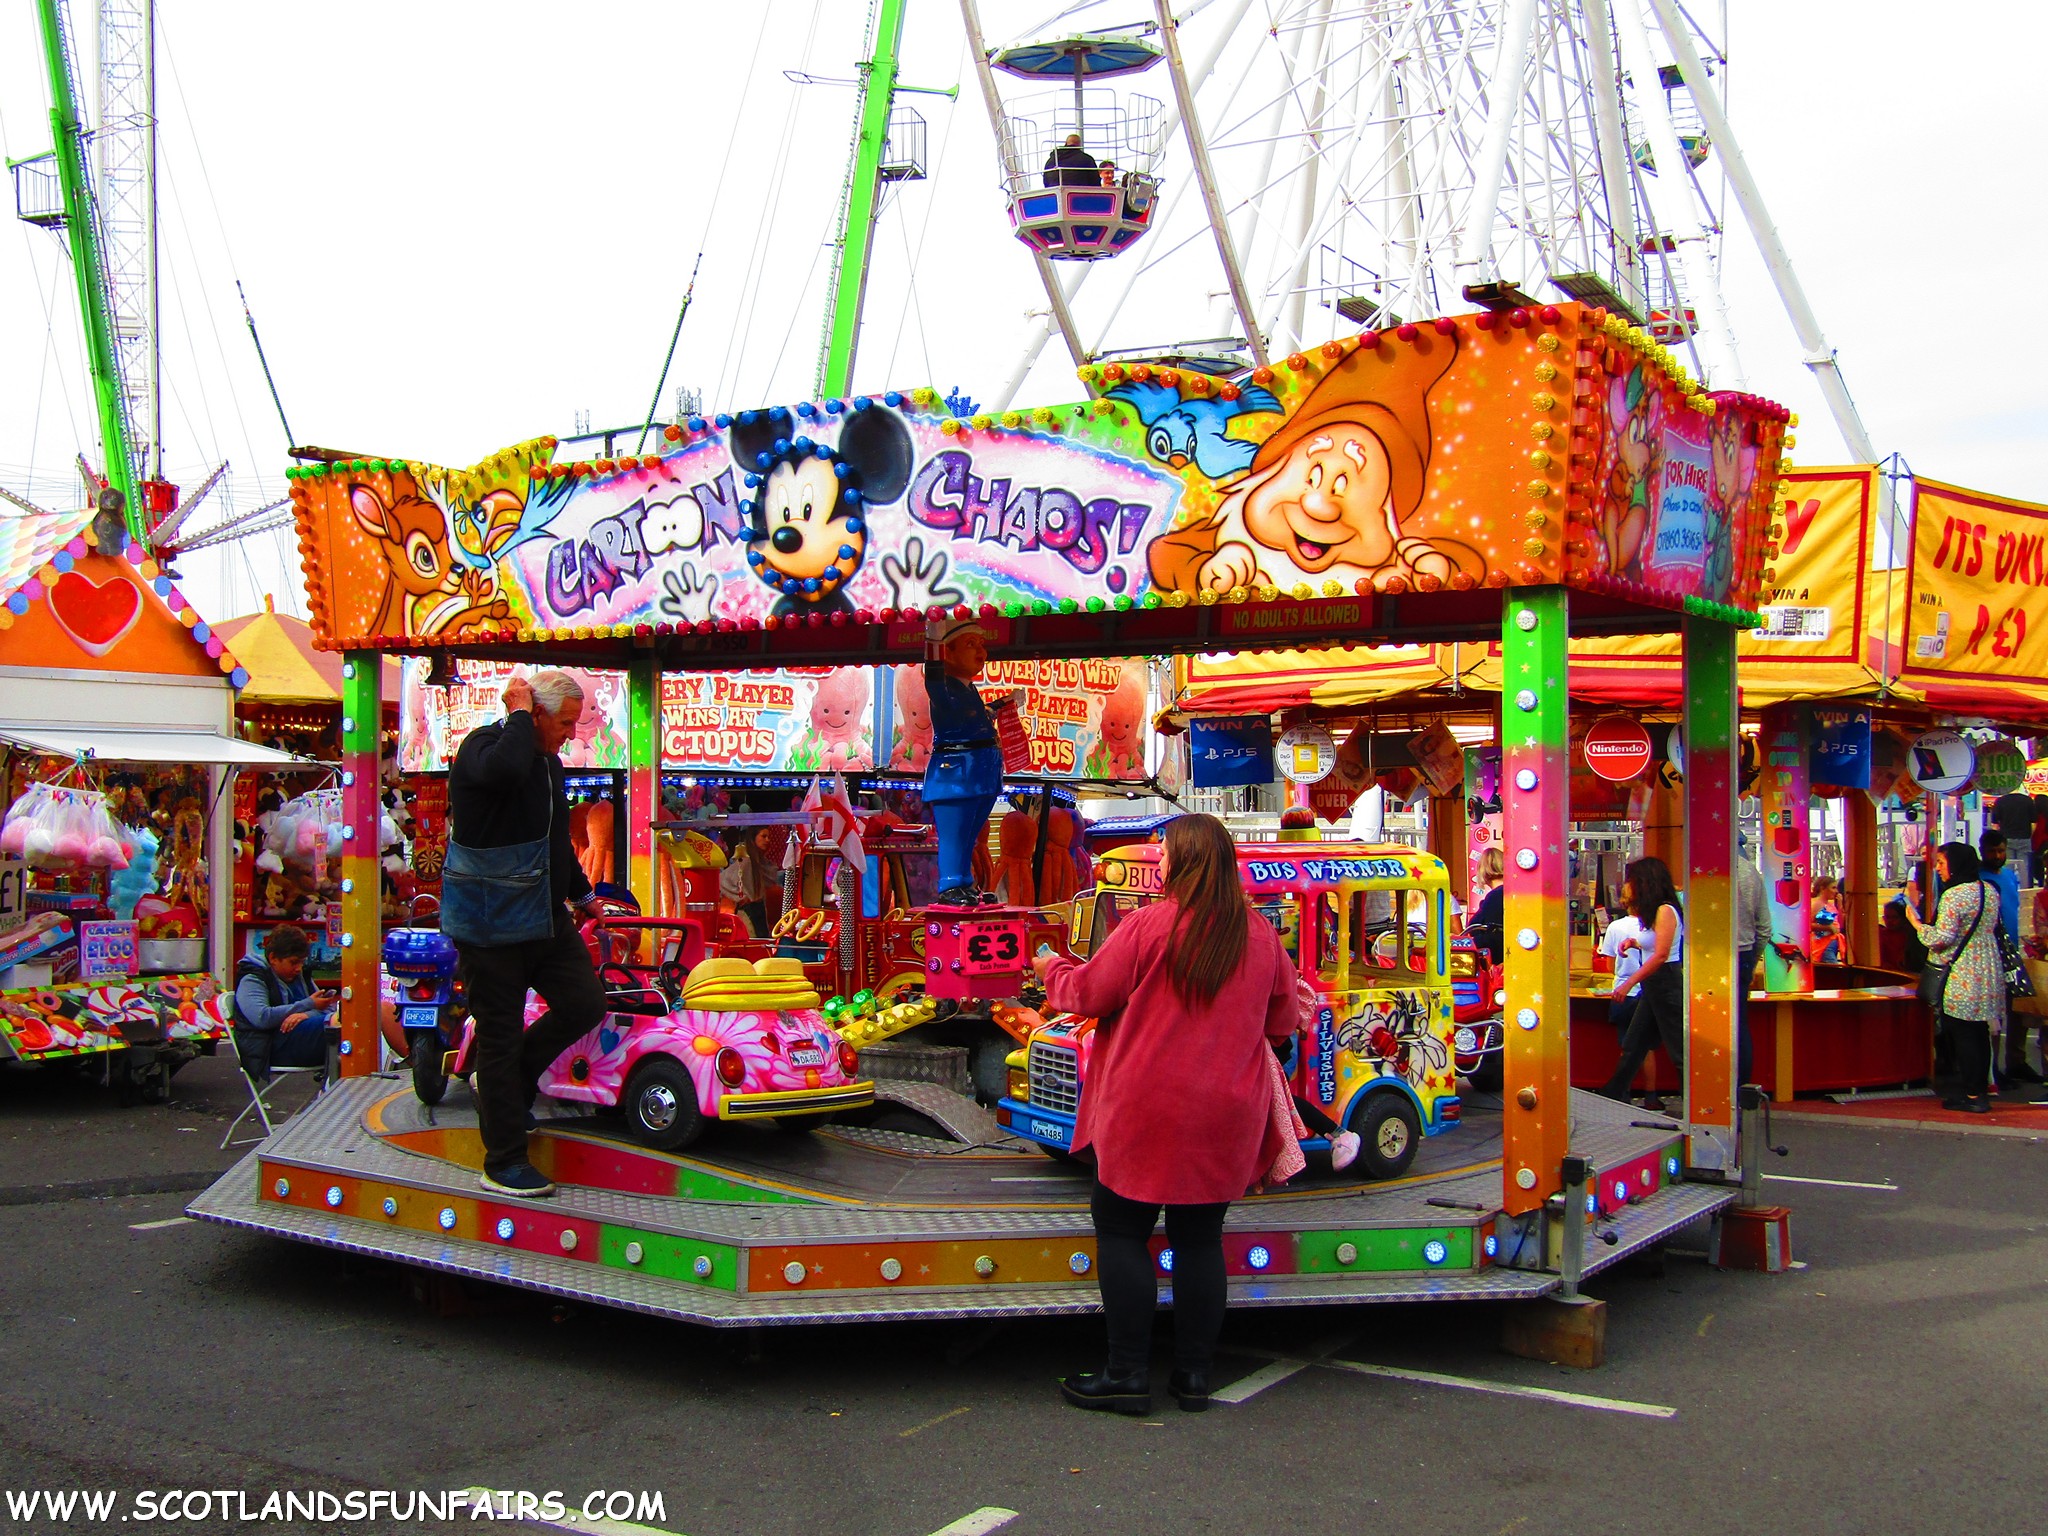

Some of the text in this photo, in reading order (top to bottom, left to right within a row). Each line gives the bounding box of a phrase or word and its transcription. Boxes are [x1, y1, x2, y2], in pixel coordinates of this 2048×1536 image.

[1665, 460, 1708, 493] FOR HIRE
[545, 450, 1153, 618] CARTOON CHAOS!
[1933, 515, 2048, 587] ITS ONL
[1771, 588, 1809, 600] WIN A
[1919, 592, 1937, 606] WIN
[1233, 605, 1360, 629] NO ADULTS ALLOWED
[1039, 659, 1051, 682] 3
[1056, 660, 1079, 684] TO
[1084, 659, 1121, 689] WIN
[662, 676, 793, 705] ERY PLAYER
[1026, 688, 1088, 718] PLAYER
[664, 705, 755, 728] WINS AN
[1196, 720, 1266, 732] WIN A
[1814, 711, 1868, 724] WIN A
[1038, 718, 1058, 737] AN
[662, 730, 775, 757] CTOPUS
[1592, 744, 1643, 753] Nintendo
[1831, 744, 1858, 755] PS5
[1925, 738, 1943, 746] iPad
[1223, 747, 1258, 758] PS5
[1769, 751, 1800, 767] OVER
[1776, 771, 1793, 786] TO
[1317, 793, 1348, 808] OVER
[1129, 867, 1163, 890] BUS
[1249, 858, 1406, 881] BUS WARNER
[86, 926, 131, 937] CANDY
[977, 924, 1009, 932] FARE
[1073, 904, 1082, 940] BUS
[86, 940, 134, 960] £1.00
[967, 933, 1019, 962] £3
[1319, 1008, 1335, 1103] SILVESTRE
